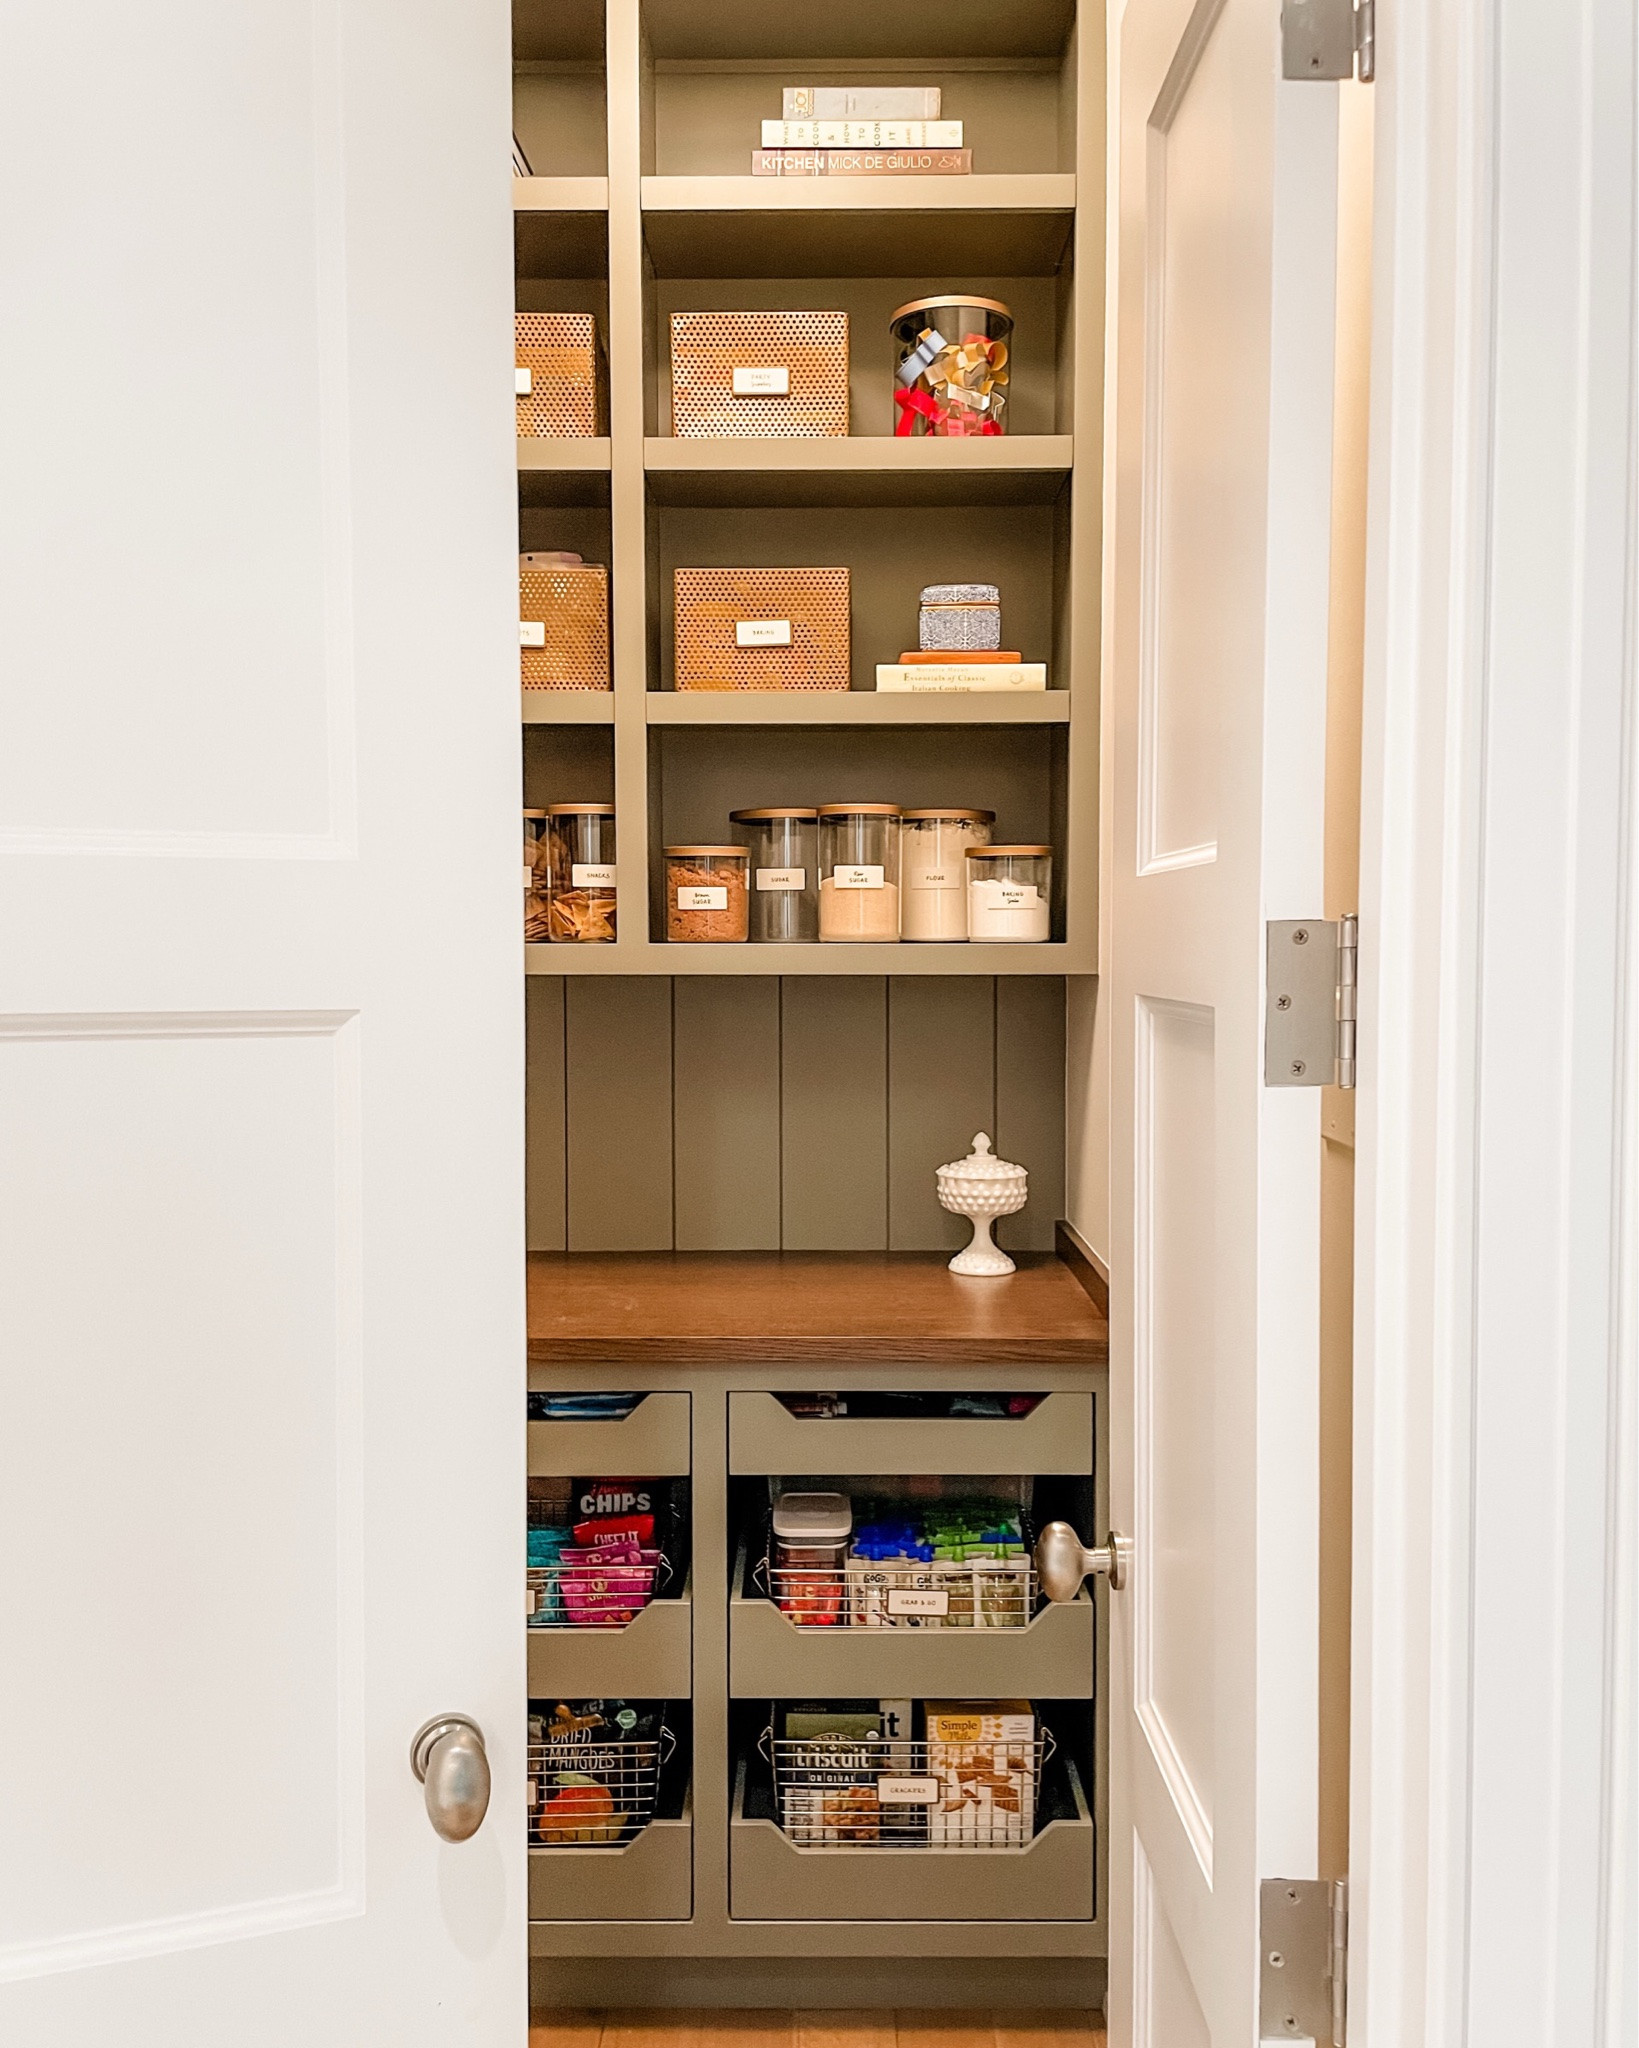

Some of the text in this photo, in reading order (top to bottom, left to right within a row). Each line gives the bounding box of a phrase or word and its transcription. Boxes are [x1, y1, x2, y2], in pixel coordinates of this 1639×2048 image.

[798, 128, 803, 138] TO
[859, 128, 865, 138] TO
[889, 131, 896, 140] IT
[762, 156, 932, 170] KITCHEN MICK DE GIULIO
[904, 672, 945, 681] Essentials
[948, 674, 954, 683] of
[580, 1493, 651, 1514] CHIPS
[941, 1720, 978, 1731] Simple
[548, 1747, 615, 1770] MANGOES
[796, 1746, 870, 1768] triscuit
[810, 1774, 855, 1782] ORGINAL
